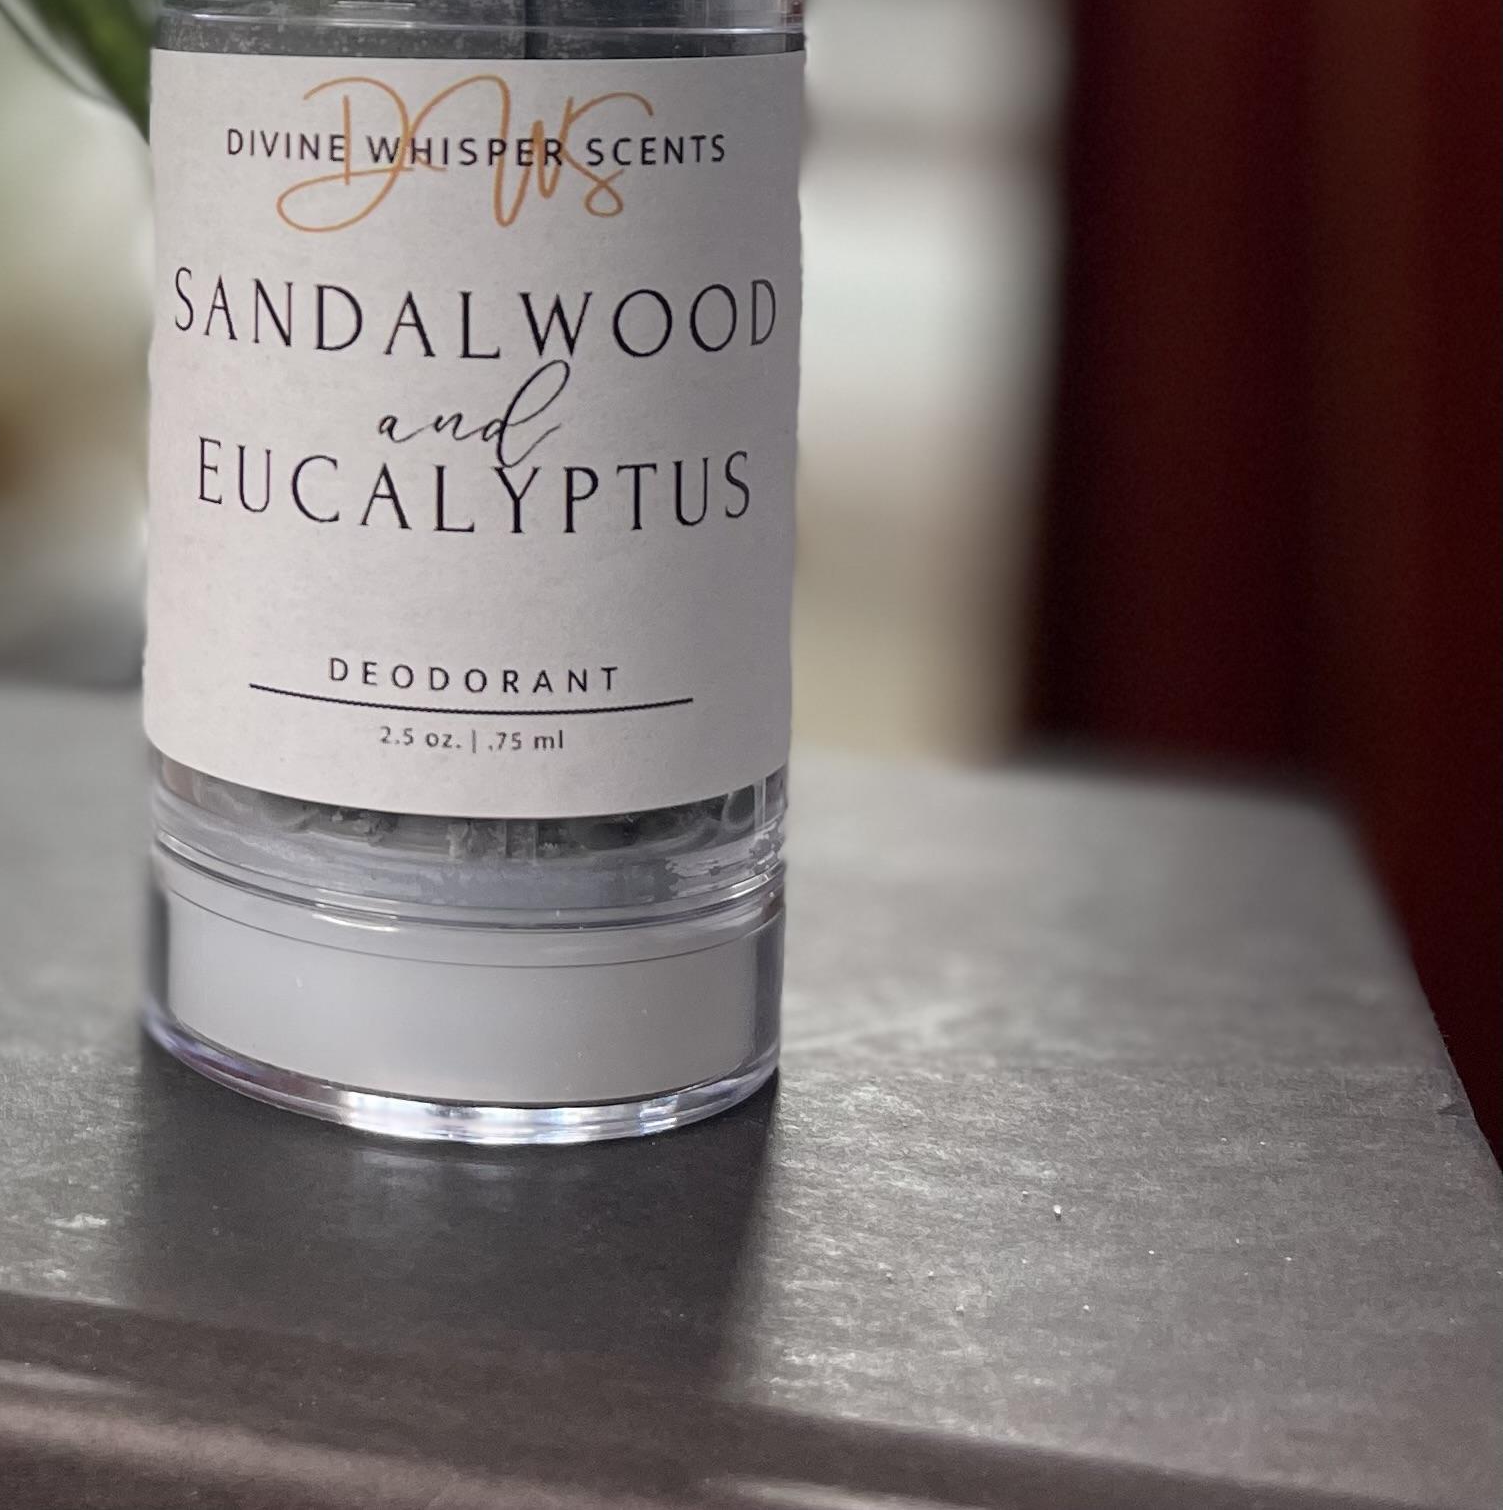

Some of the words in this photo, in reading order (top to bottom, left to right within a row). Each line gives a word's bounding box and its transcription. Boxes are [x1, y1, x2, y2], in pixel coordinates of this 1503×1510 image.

[226, 127, 347, 163] DIVINE
[366, 135, 564, 167] WHISPER
[586, 134, 727, 166] SCENTS
[174, 266, 777, 360] SANDALWOOD
[378, 359, 571, 468] and
[198, 436, 752, 534] EUCALYPTUS
[329, 656, 619, 693] DEODORANT
[380, 725, 415, 747] 2.5
[425, 732, 463, 749] oz.
[487, 731, 523, 752] .75
[534, 729, 565, 750] ml
